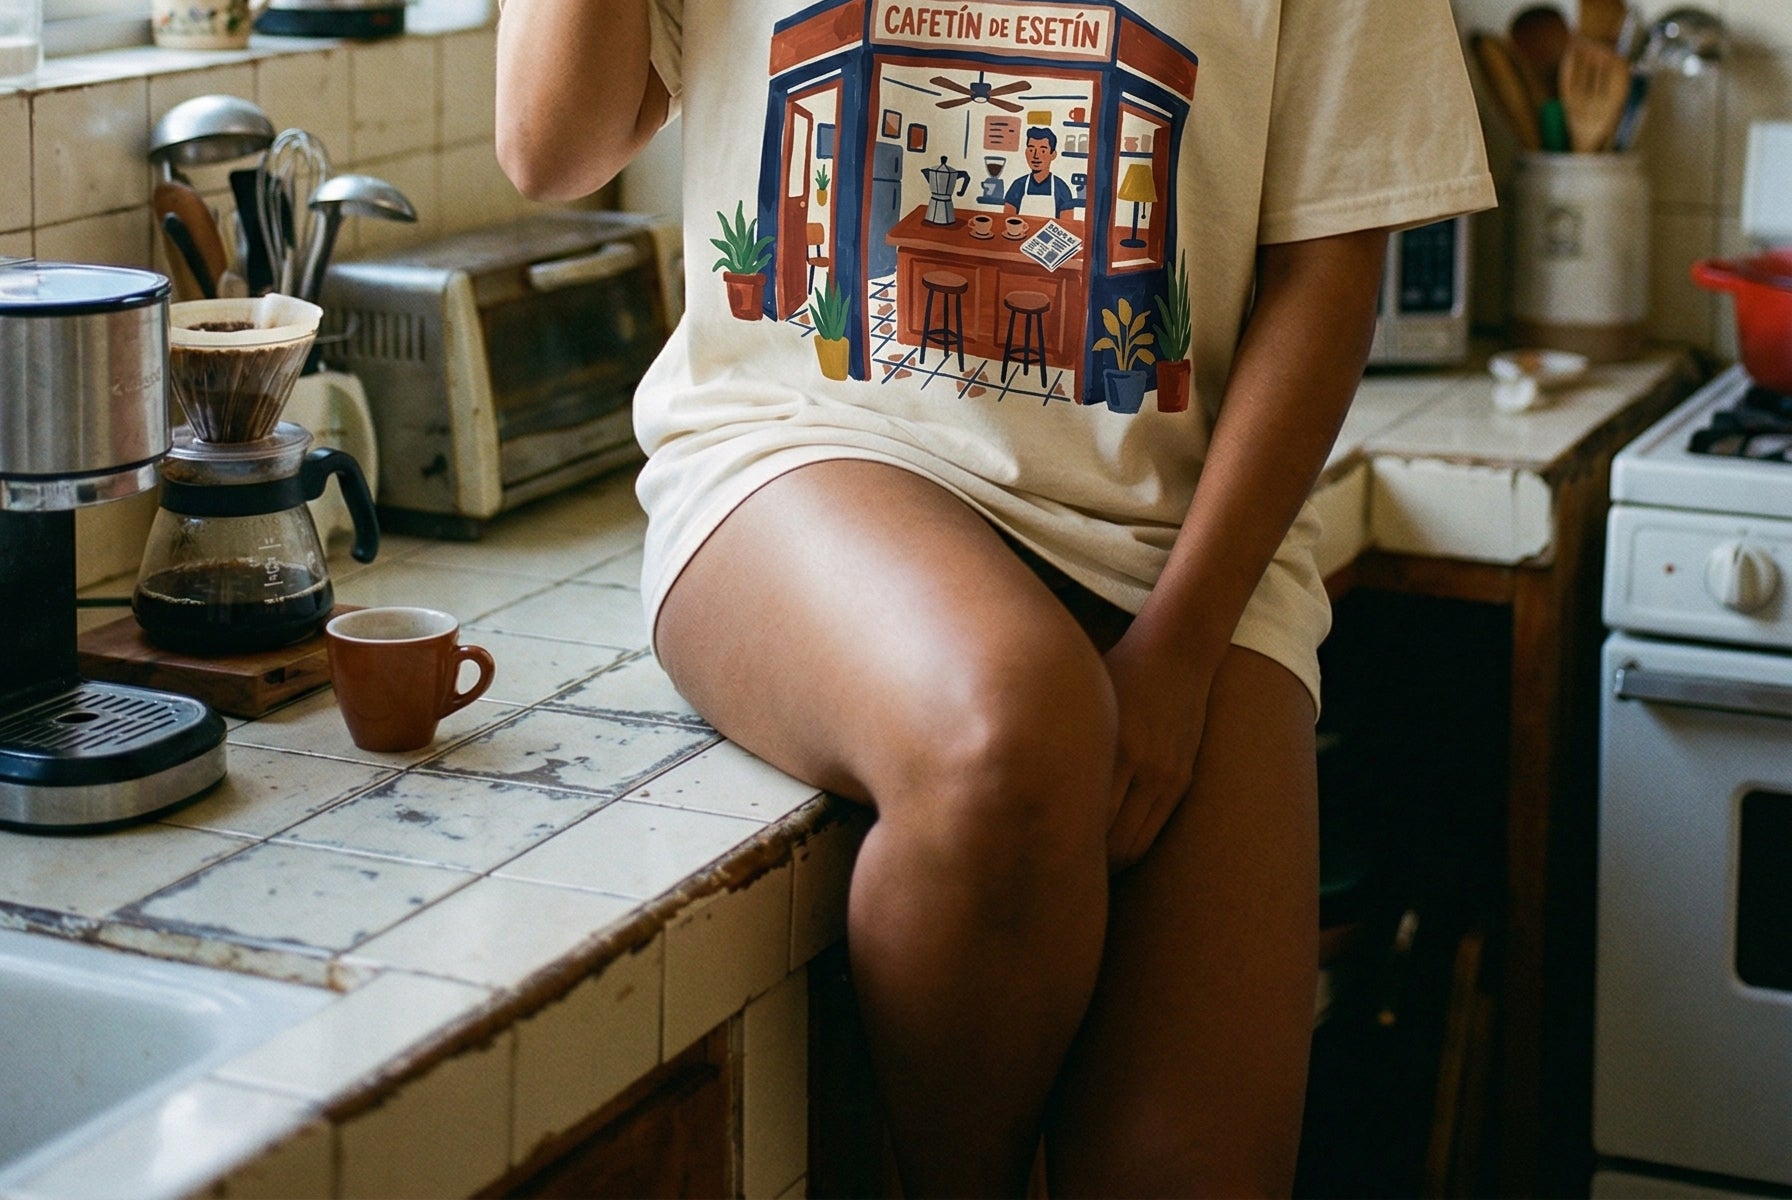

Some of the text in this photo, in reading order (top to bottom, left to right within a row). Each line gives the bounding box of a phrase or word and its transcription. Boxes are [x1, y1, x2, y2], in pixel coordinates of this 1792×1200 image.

[884, 3, 1100, 49] CAFETÍN DE ESETÍN
